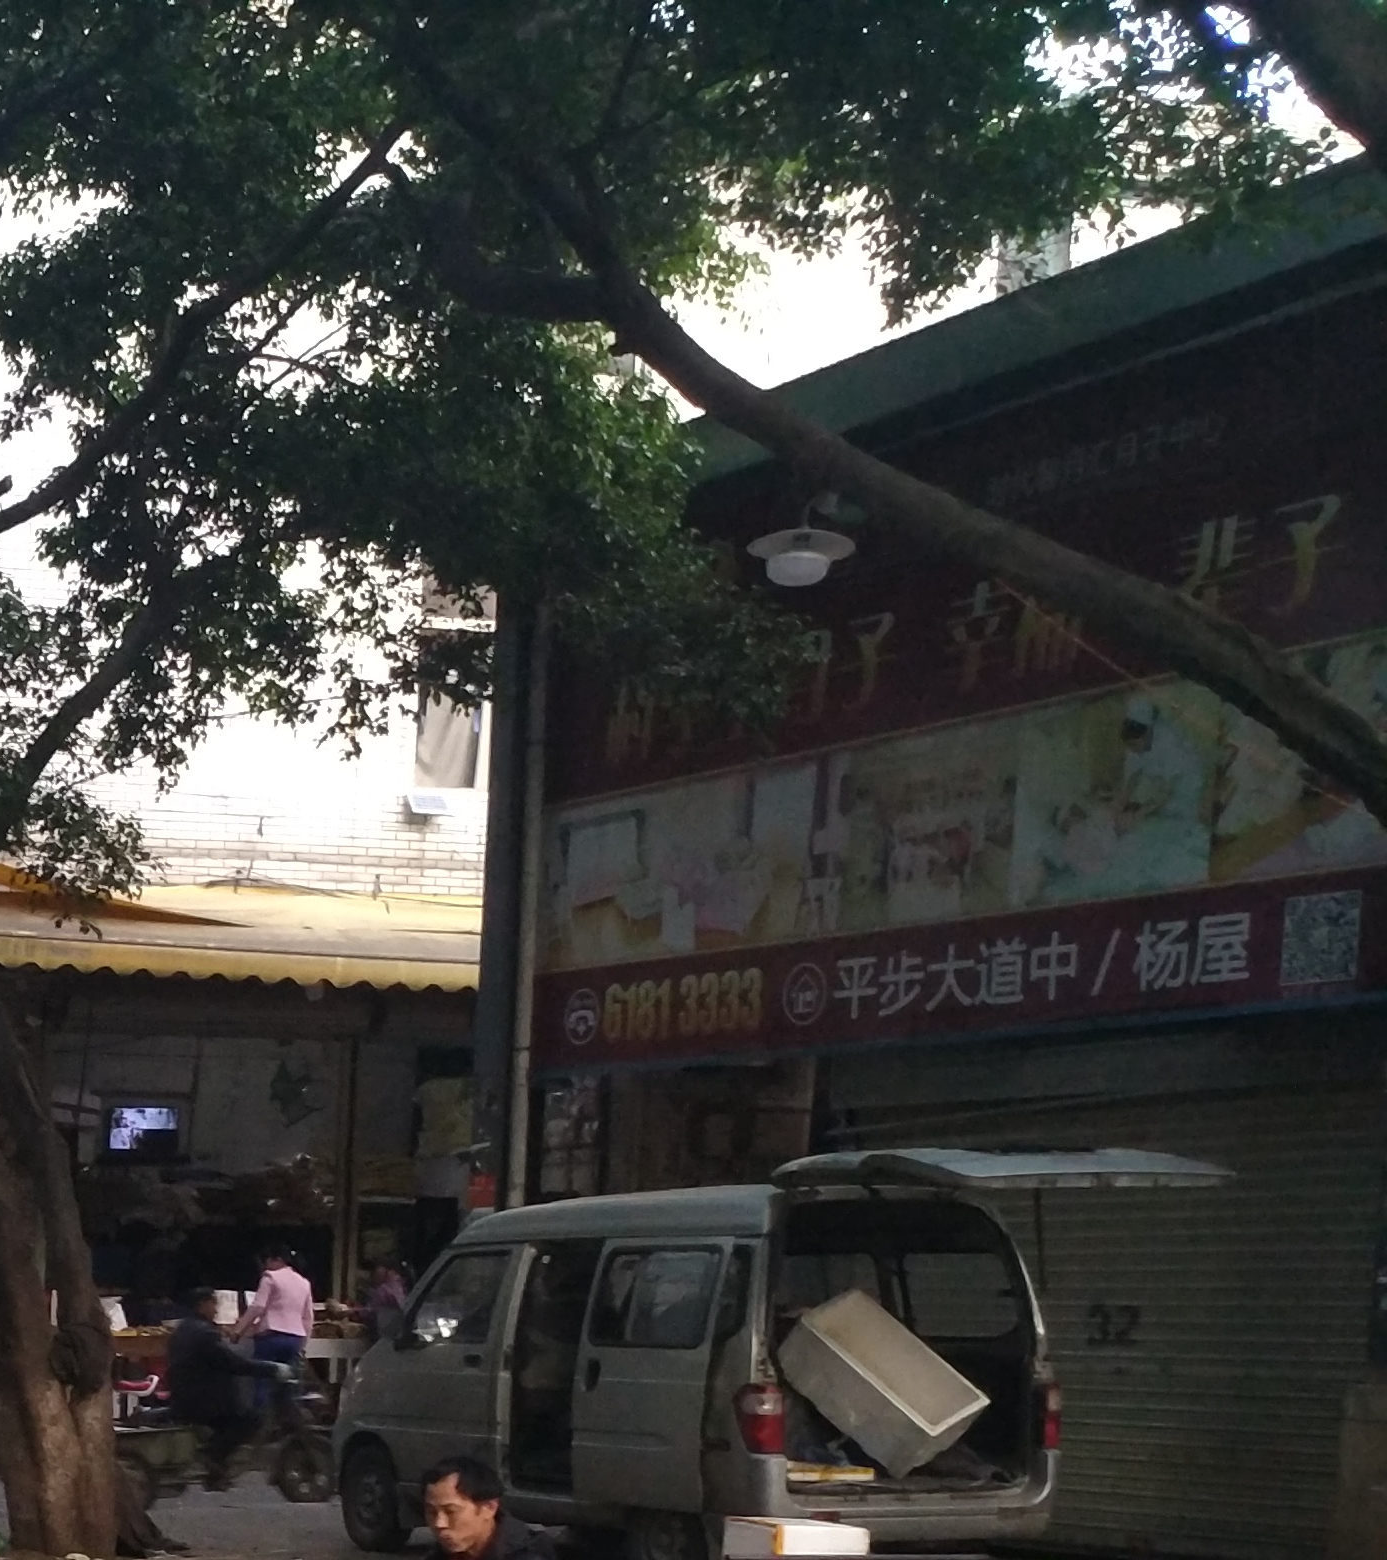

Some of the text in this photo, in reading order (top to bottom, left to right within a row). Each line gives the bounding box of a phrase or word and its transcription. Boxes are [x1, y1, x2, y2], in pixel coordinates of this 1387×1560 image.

[832, 930, 1079, 1019] 平步大道中
[1133, 911, 1252, 992] 杨屋
